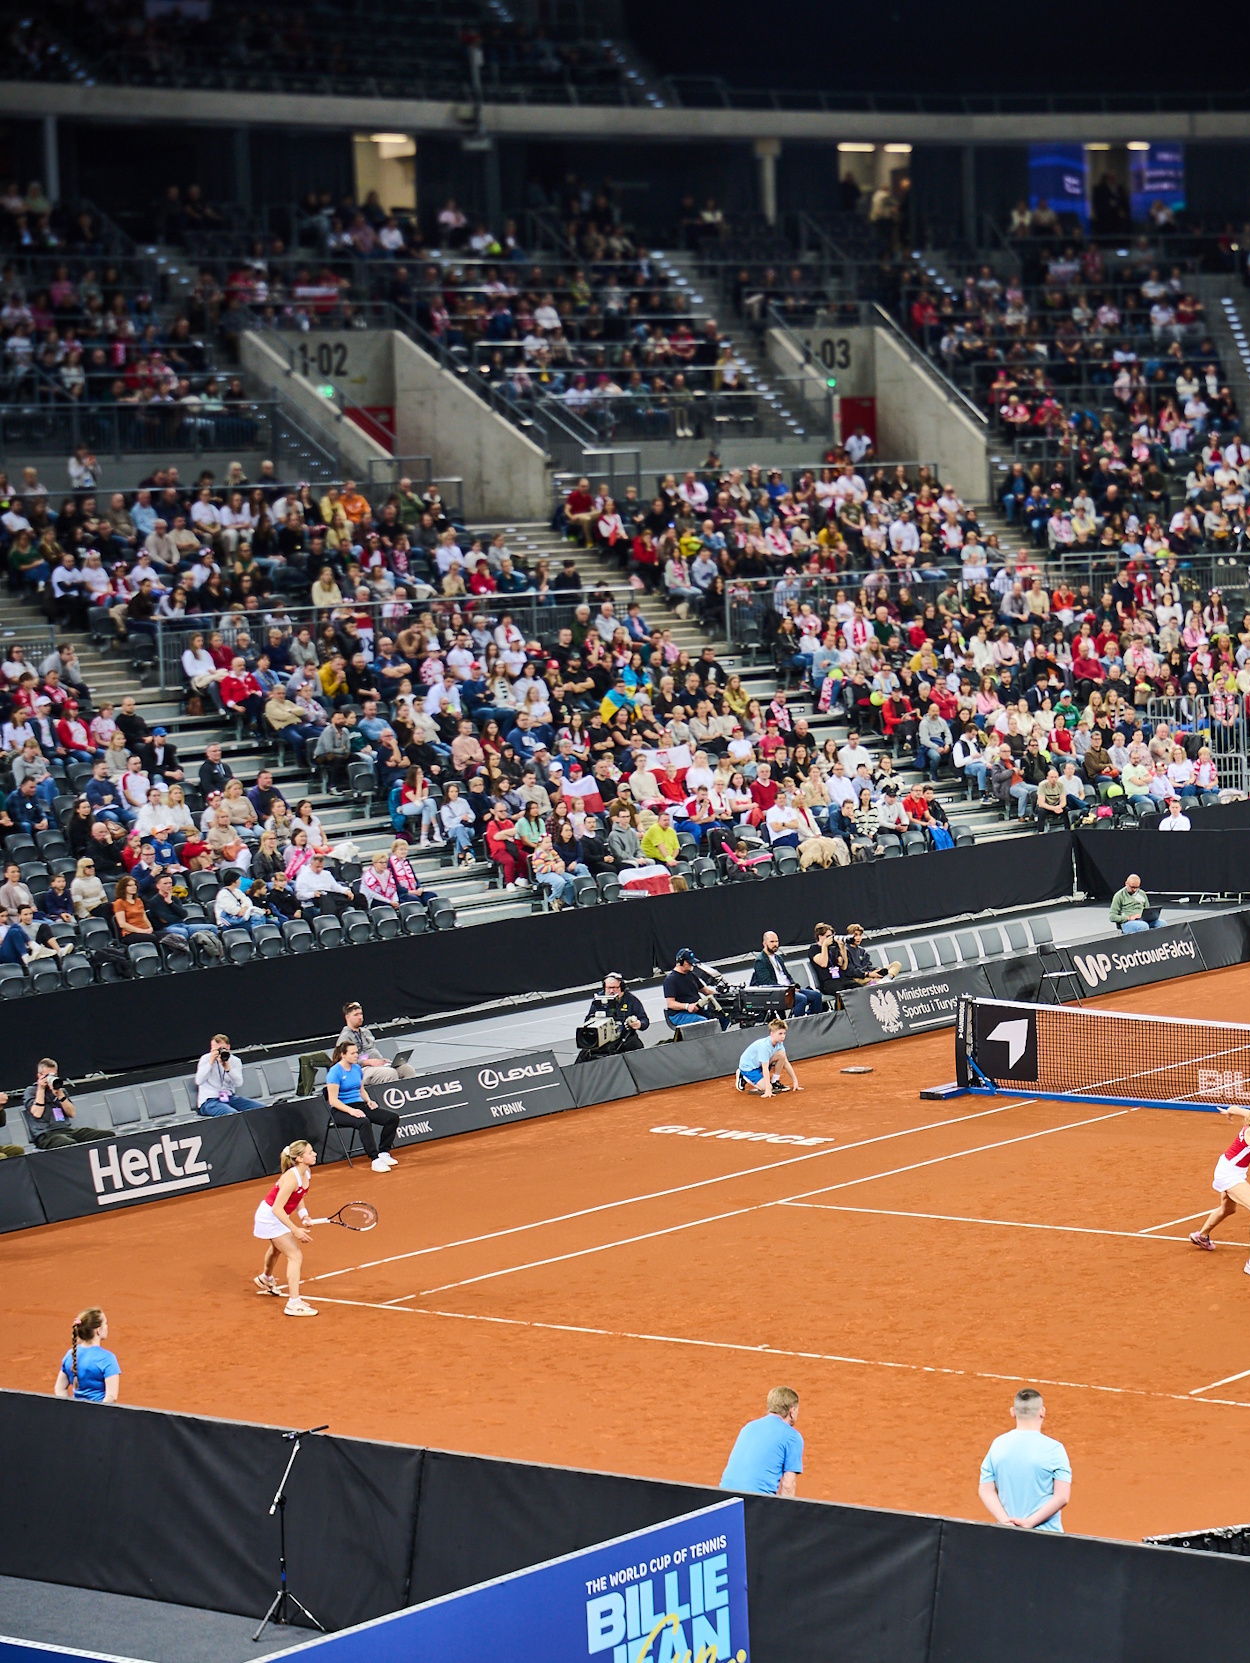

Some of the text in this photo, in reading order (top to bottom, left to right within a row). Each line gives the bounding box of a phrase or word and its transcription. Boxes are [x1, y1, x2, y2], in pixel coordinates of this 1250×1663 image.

[298, 343, 348, 377] 1-02
[1112, 940, 1195, 974] SportoweFakty
[896, 983, 950, 1002] Ministerstwo
[902, 1003, 931, 1019] Sportu
[498, 1061, 554, 1082] LEXUS
[404, 1080, 463, 1101] LEXUS
[490, 1100, 526, 1118] RYBNIK
[396, 1120, 433, 1139] RYBNIK
[649, 1125, 835, 1147] GLIWICE
[89, 1134, 208, 1193] Hertz
[585, 1534, 727, 1595] THE WORLD CUP OF TENNIS
[586, 1552, 730, 1655] BILLIE
